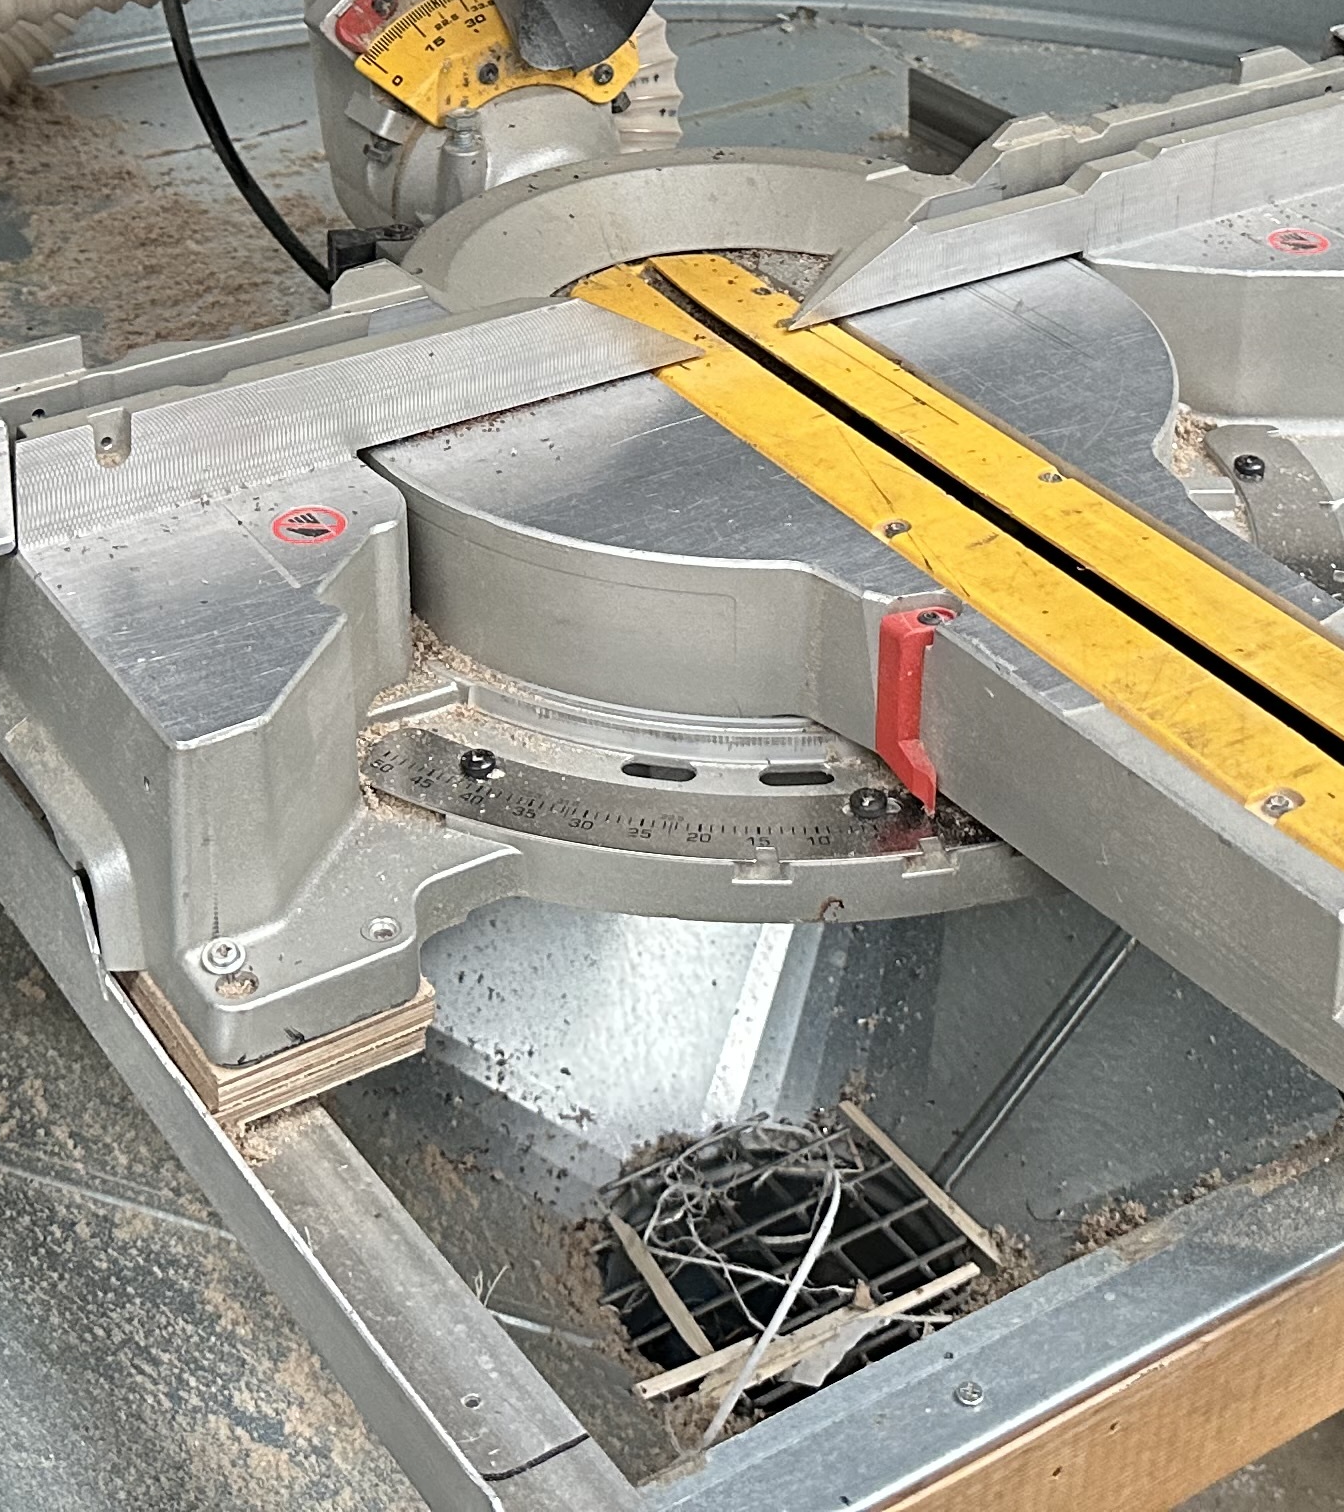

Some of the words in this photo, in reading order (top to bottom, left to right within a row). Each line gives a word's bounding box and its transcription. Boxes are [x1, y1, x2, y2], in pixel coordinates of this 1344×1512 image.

[391, 74, 404, 87] 0
[464, 13, 487, 28] 30
[410, 775, 434, 788] 45
[459, 792, 484, 805] 40
[512, 806, 536, 819] 35
[568, 818, 594, 830] 30
[628, 827, 652, 839] 25
[686, 832, 711, 843] 20
[747, 836, 771, 847] 15
[809, 836, 831, 846] 10
